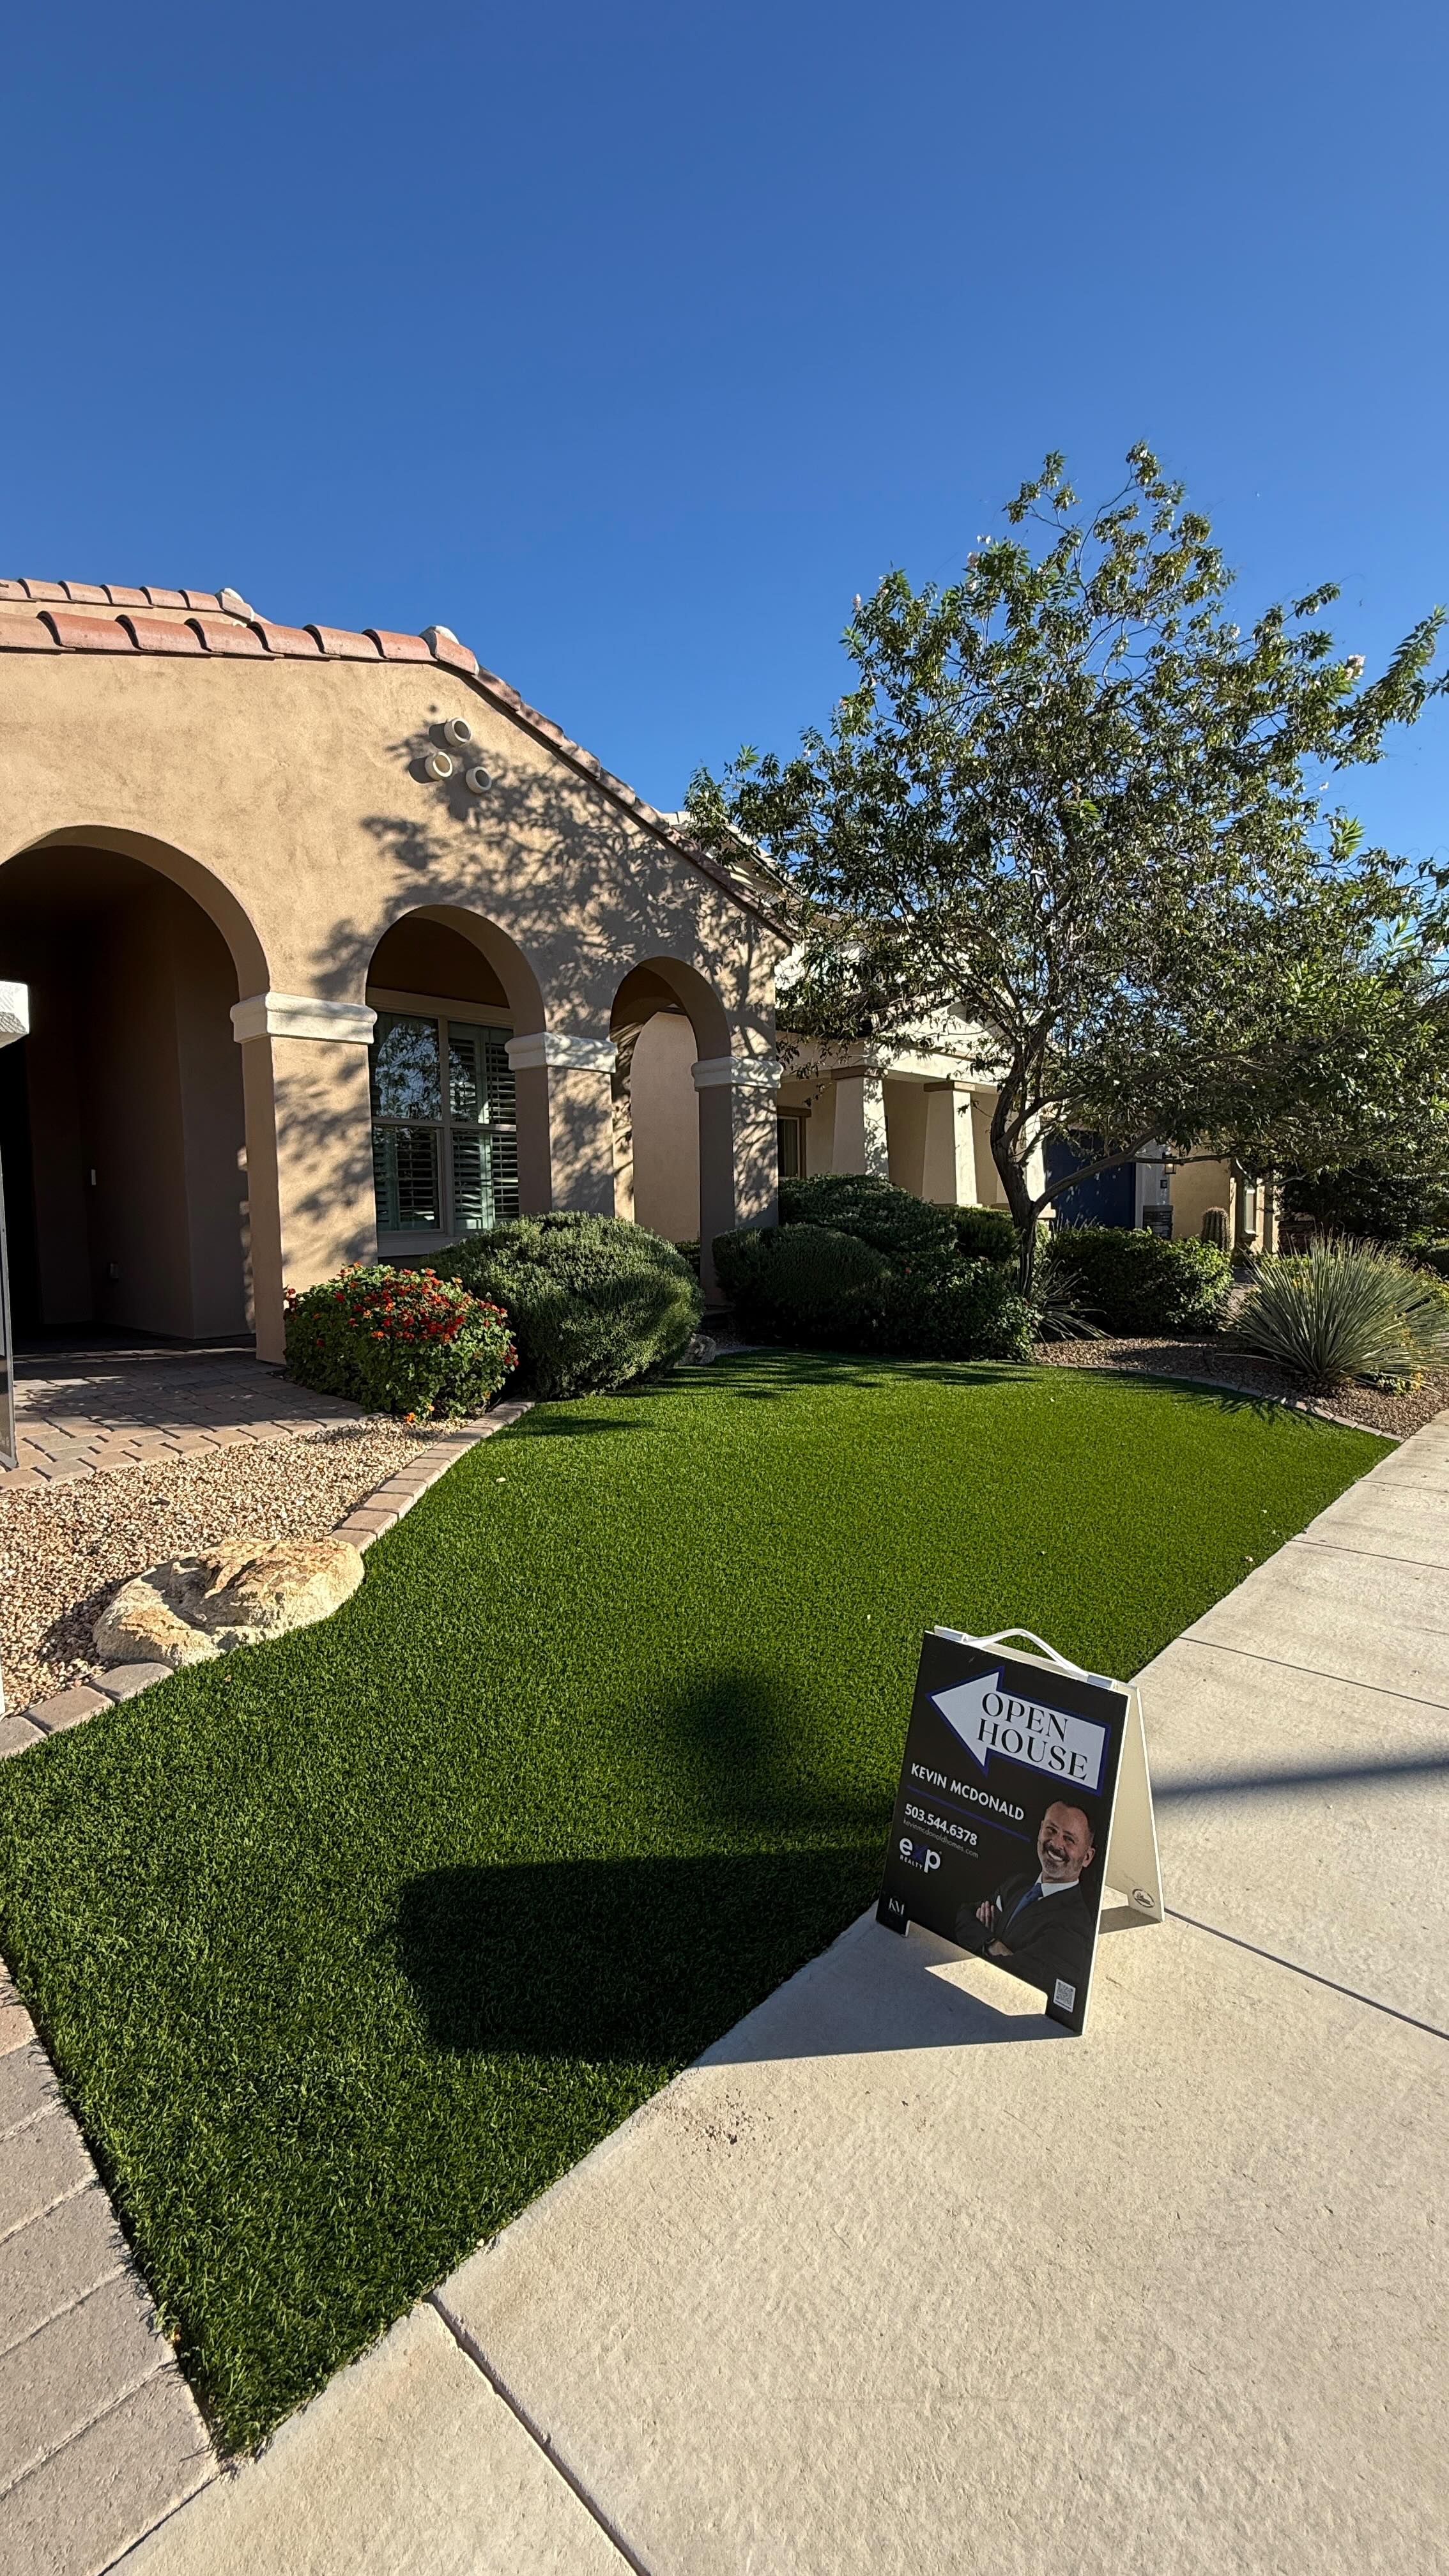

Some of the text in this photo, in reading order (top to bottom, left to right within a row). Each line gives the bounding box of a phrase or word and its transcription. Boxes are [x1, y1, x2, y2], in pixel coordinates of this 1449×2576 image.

[982, 1692, 1068, 1742] OPEN
[977, 1718, 1088, 1781] HOUSE
[910, 1763, 1025, 1820] KEVIN MCDONALD
[905, 1804, 977, 1846] 503.544.6378
[900, 1855, 923, 1870] REALTY
